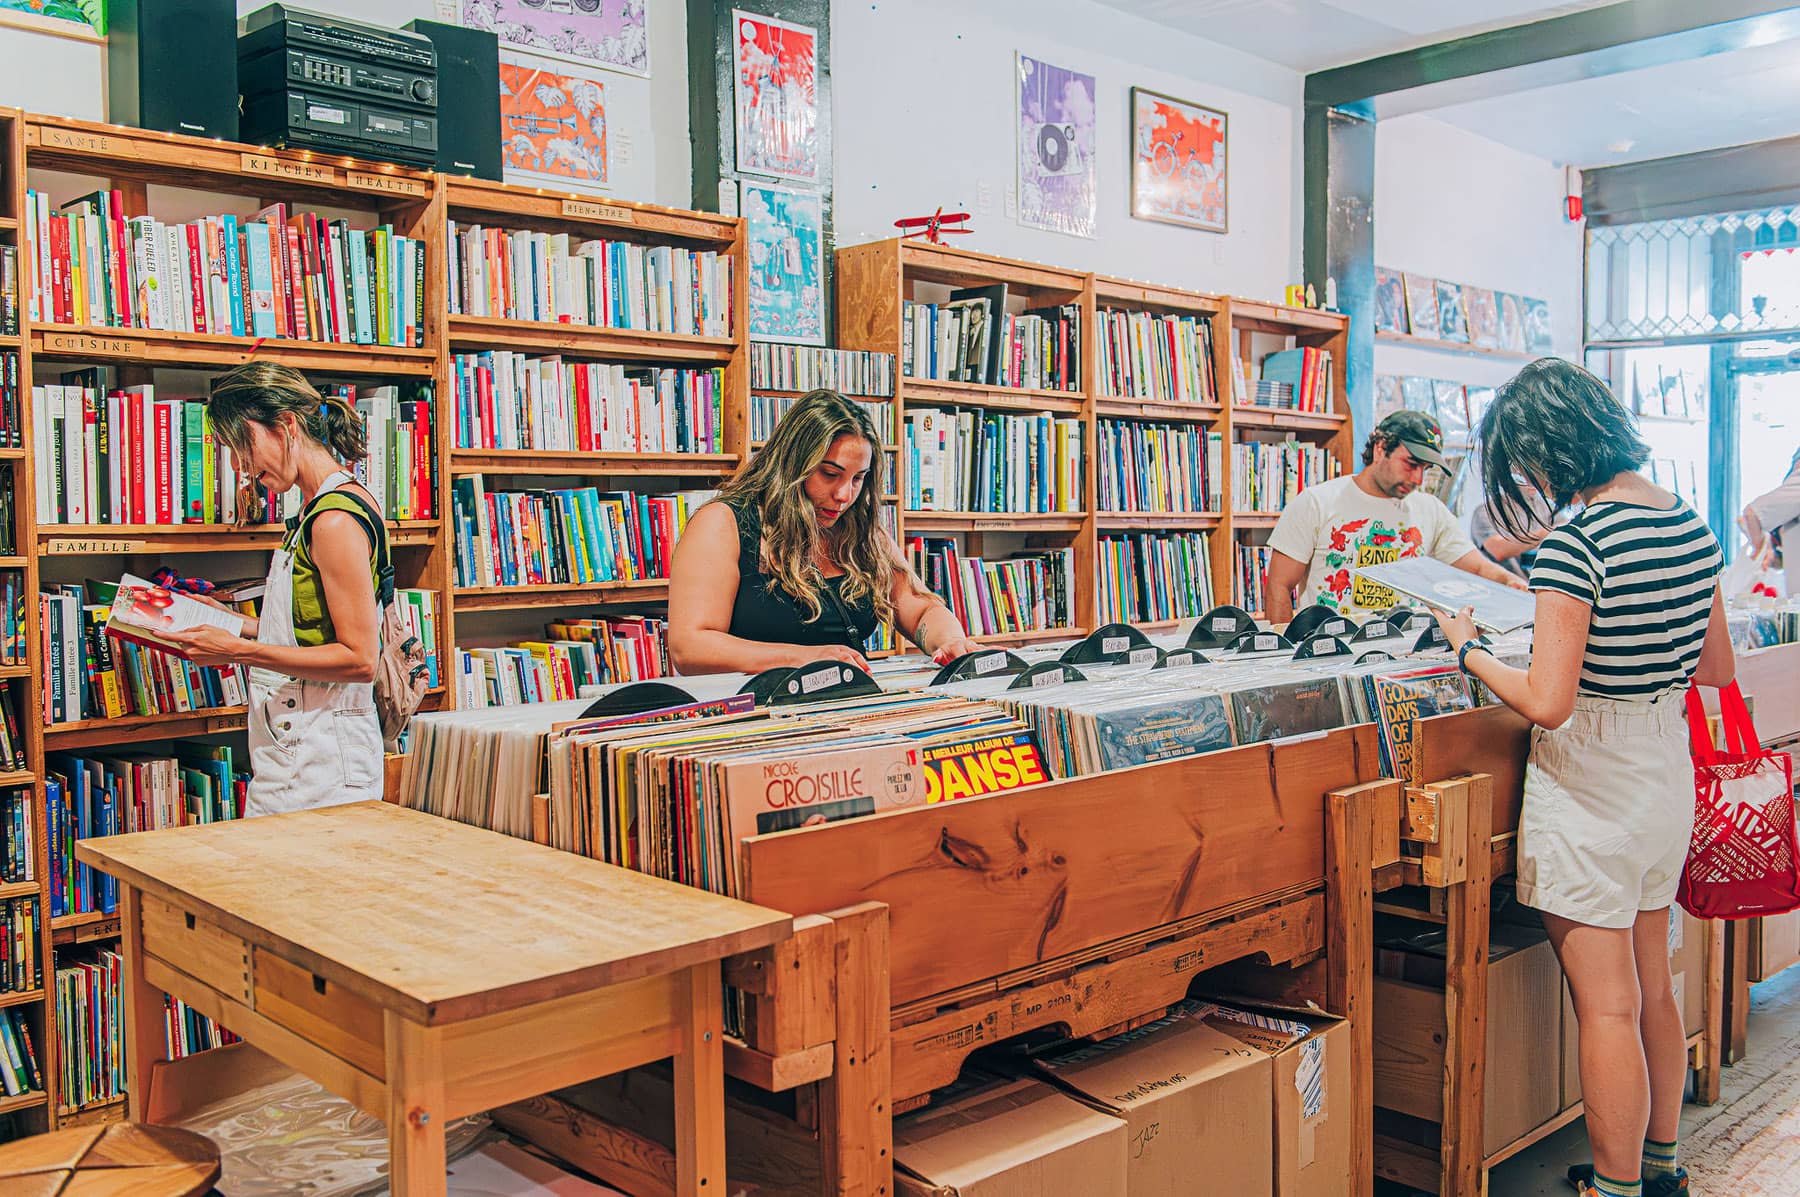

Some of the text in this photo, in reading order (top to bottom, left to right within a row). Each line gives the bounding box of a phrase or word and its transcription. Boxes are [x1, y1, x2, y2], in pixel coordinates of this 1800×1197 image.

[53, 132, 108, 150] SANTÉ
[251, 159, 322, 177] KITCHEN
[356, 175, 413, 193] HEALTH
[143, 219, 157, 273] FIBER FUELED
[170, 232, 180, 295] WHEAT BELLY
[55, 338, 131, 353] CUISINE
[161, 486, 168, 494] LA
[56, 542, 131, 553] FAMILLE
[1360, 549, 1394, 565] KING
[98, 625, 109, 662] La Cuisine
[52, 647, 60, 669] futée
[68, 648, 76, 666] futée
[52, 669, 61, 700] Famille
[68, 667, 77, 696] Famille
[1387, 701, 1420, 723] DAYS
[1391, 722, 1409, 743] OF
[923, 749, 932, 762] LE
[932, 742, 972, 760] MEILLEUR
[973, 737, 1001, 752] ALBUM
[1003, 736, 1014, 747] DE
[763, 760, 799, 779] NICOLE
[923, 745, 1043, 805] DANSE
[765, 767, 864, 809] CROISILLE
[1695, 821, 1728, 854] dentaire
[1026, 1003, 1042, 1018] MP
